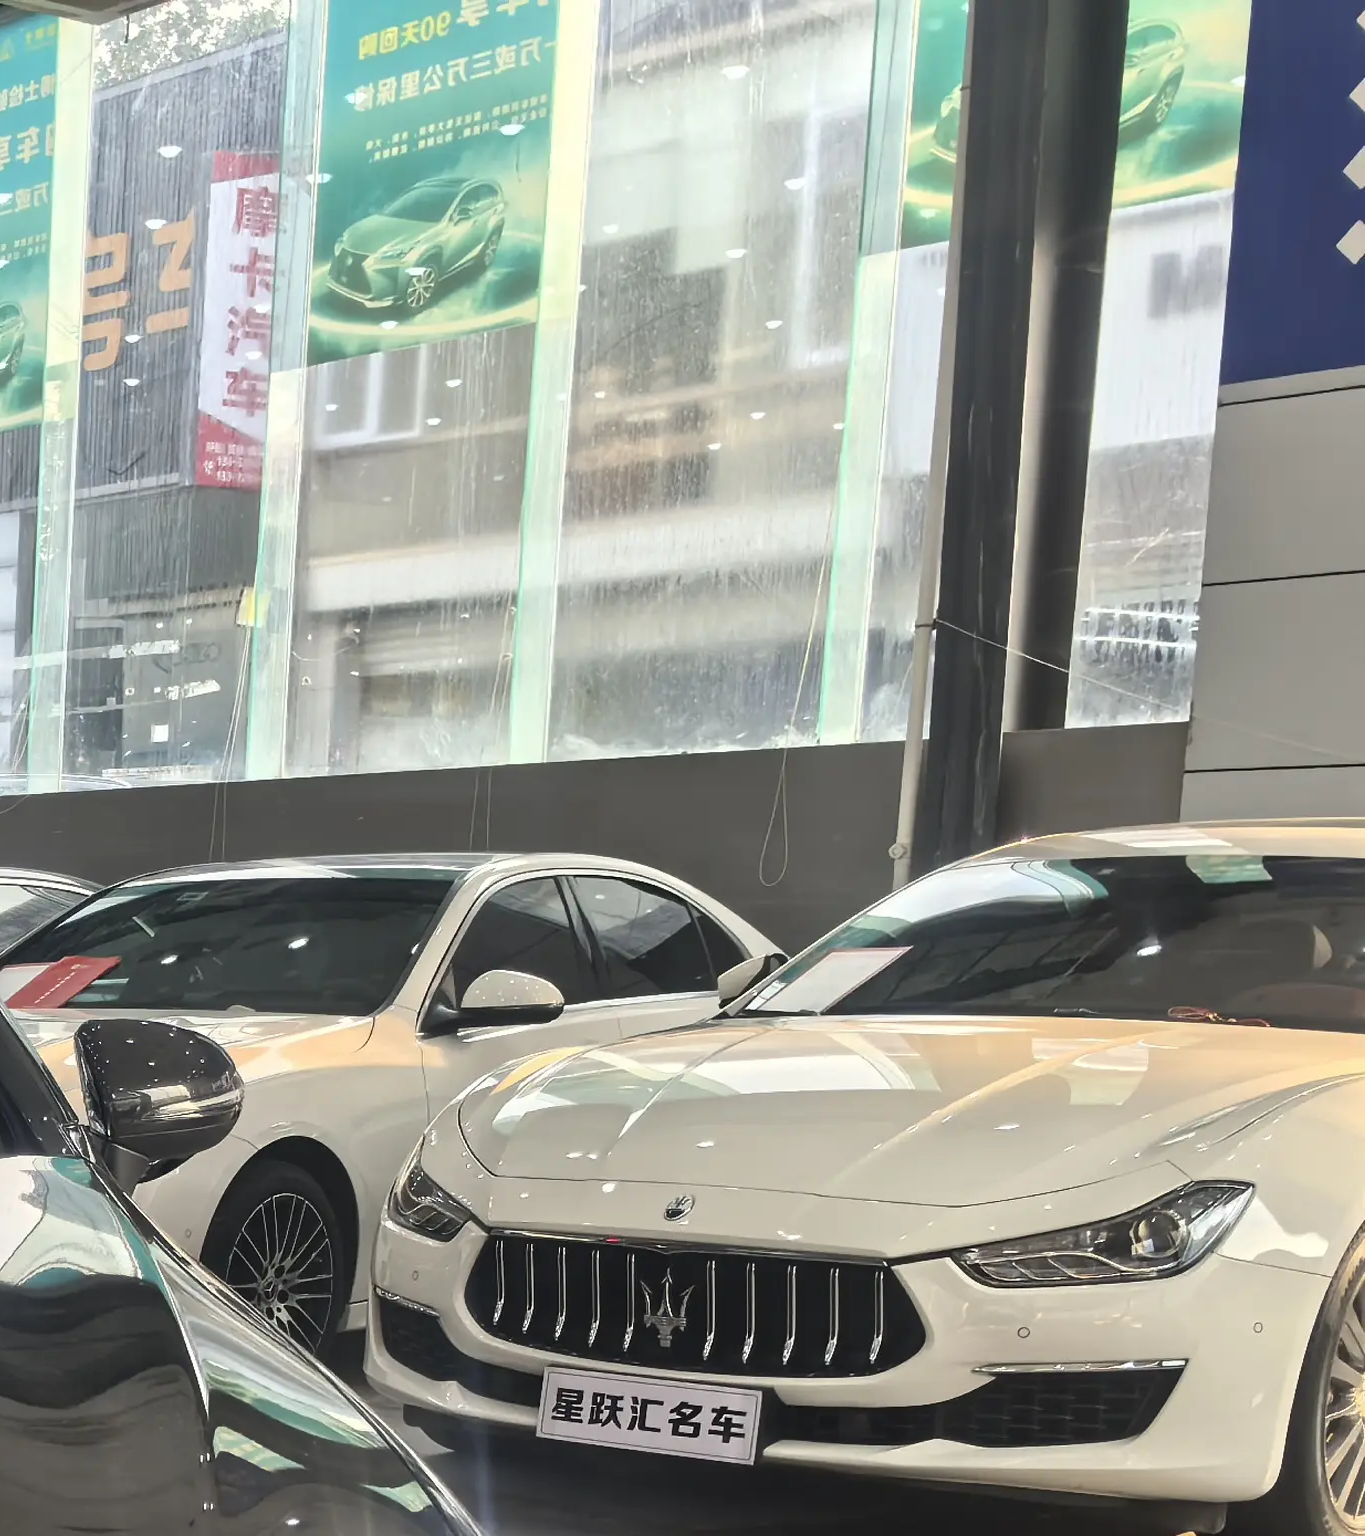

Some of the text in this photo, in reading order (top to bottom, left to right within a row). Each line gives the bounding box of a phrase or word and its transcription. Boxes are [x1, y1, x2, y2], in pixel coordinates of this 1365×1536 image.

[550, 1386, 748, 1444] 星跃汇名车
